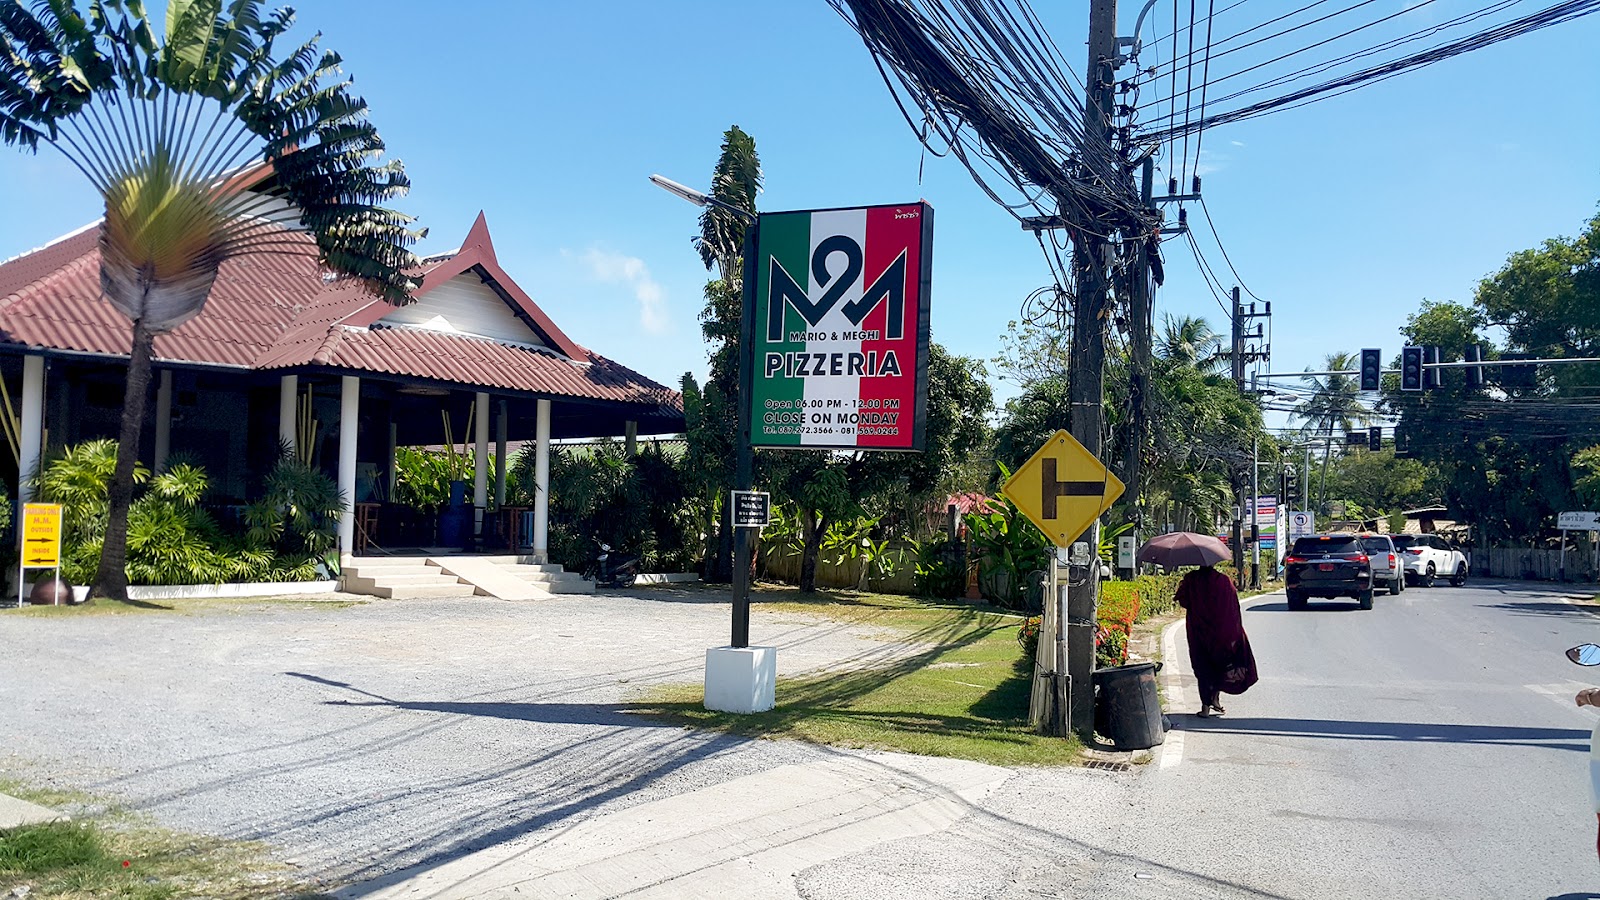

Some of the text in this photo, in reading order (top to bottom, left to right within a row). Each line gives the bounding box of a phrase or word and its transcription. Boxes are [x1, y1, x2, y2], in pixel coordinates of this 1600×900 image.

[789, 330, 880, 342] MARIO & MEGHI
[764, 350, 902, 378] PIZZERIA
[764, 399, 792, 410] Open
[795, 399, 823, 409] 06.00
[826, 399, 842, 408] PM
[852, 399, 880, 408] 12.00
[883, 399, 900, 408] PM
[763, 412, 899, 424] CLOSE ON MONDAY
